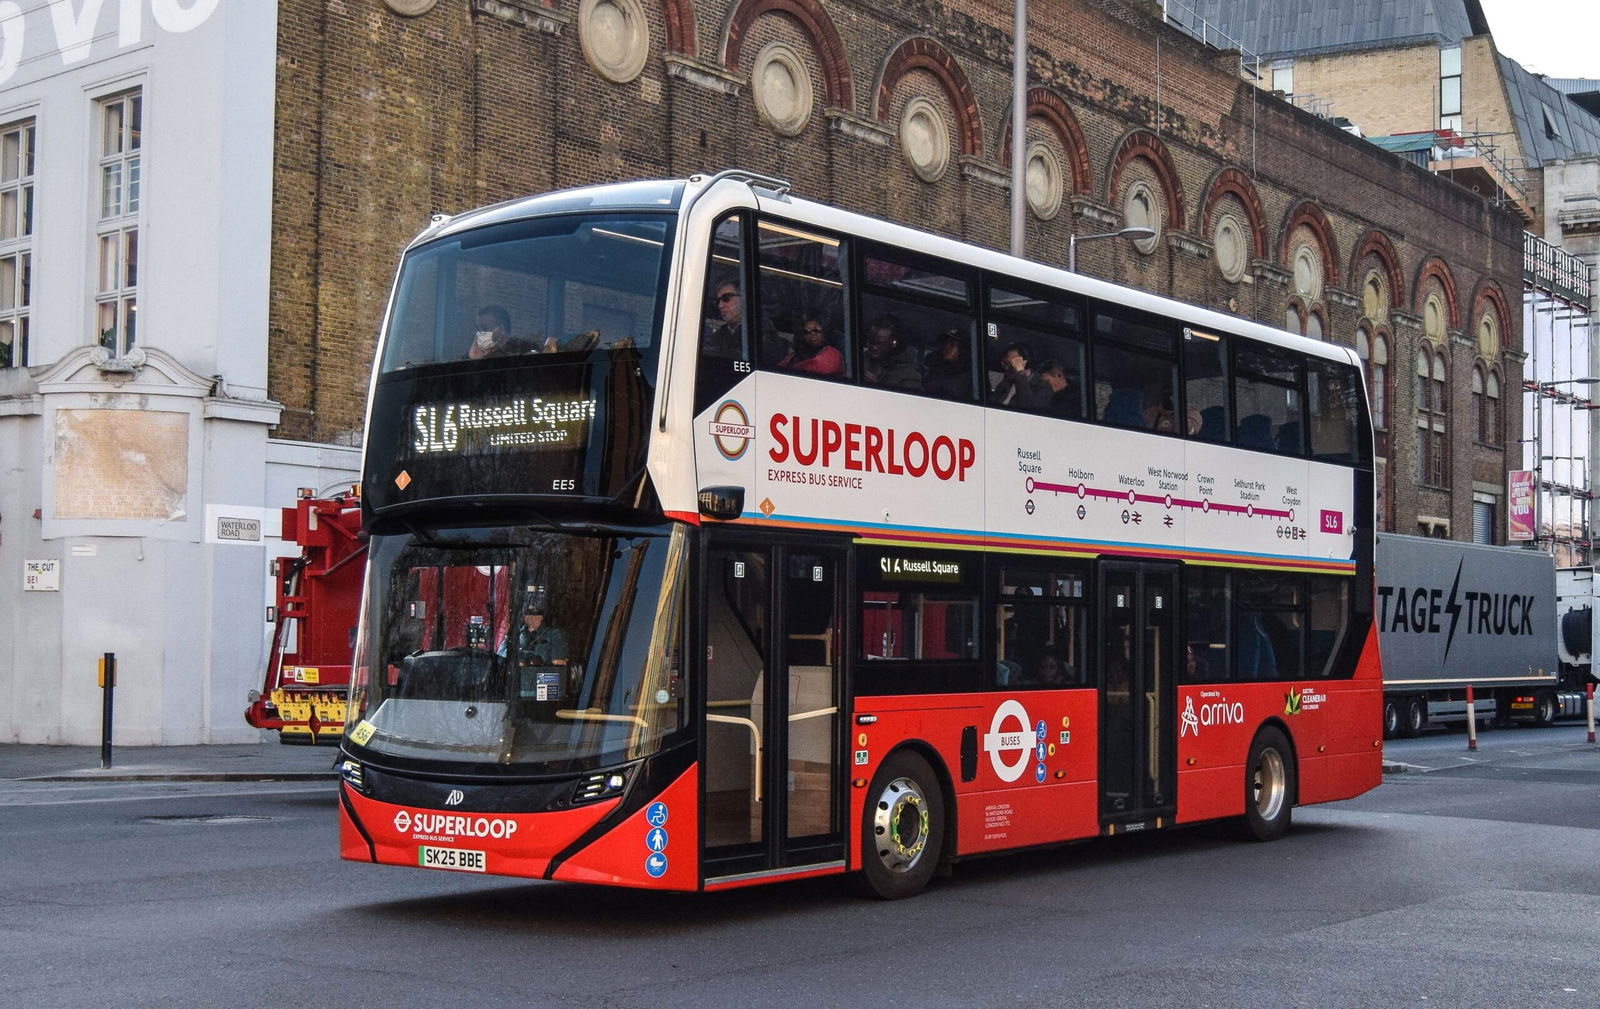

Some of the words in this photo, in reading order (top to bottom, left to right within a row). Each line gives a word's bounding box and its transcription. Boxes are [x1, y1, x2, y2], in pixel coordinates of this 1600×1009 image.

[414, 405, 458, 453] SL6
[460, 400, 528, 429] Russell
[715, 424, 750, 436] SUPERLOOP
[490, 432, 536, 446] LIMITED
[538, 429, 568, 443] STOP
[768, 412, 976, 482] SUPERLOOP
[1017, 448, 1042, 461] Russell
[1018, 461, 1042, 473] Square
[1147, 466, 1162, 477] West
[1163, 468, 1189, 481] Norwood
[768, 469, 807, 485] EXPRESS
[809, 472, 826, 487] BUS
[828, 474, 863, 490] SERVICE
[1068, 467, 1095, 481] Holborn
[1118, 474, 1145, 487] Waterloo
[1197, 474, 1214, 484] Crown
[552, 479, 575, 491] EE5
[1158, 480, 1178, 491] Station
[1199, 486, 1213, 496] Point
[1234, 478, 1254, 490] Selhurst
[1255, 481, 1266, 491] Park
[1285, 485, 1298, 496] West
[1239, 490, 1260, 501] Stadium
[1281, 495, 1301, 507] Croydon
[221, 521, 257, 531] WATERLOO
[1325, 515, 1338, 529] SL6
[221, 528, 240, 537] ROAD
[28, 563, 39, 571] THE
[42, 563, 54, 571] CUT
[903, 559, 931, 573] Russell
[932, 560, 959, 575] Square
[27, 575, 38, 584] SE1
[1465, 591, 1535, 636] TRUCK
[1200, 697, 1244, 726] arriva
[356, 727, 370, 742] 456
[1001, 736, 1021, 746] BUSES
[413, 813, 518, 839] SUPERLOOP
[426, 848, 456, 866] SK25
[459, 852, 483, 868] BBE
